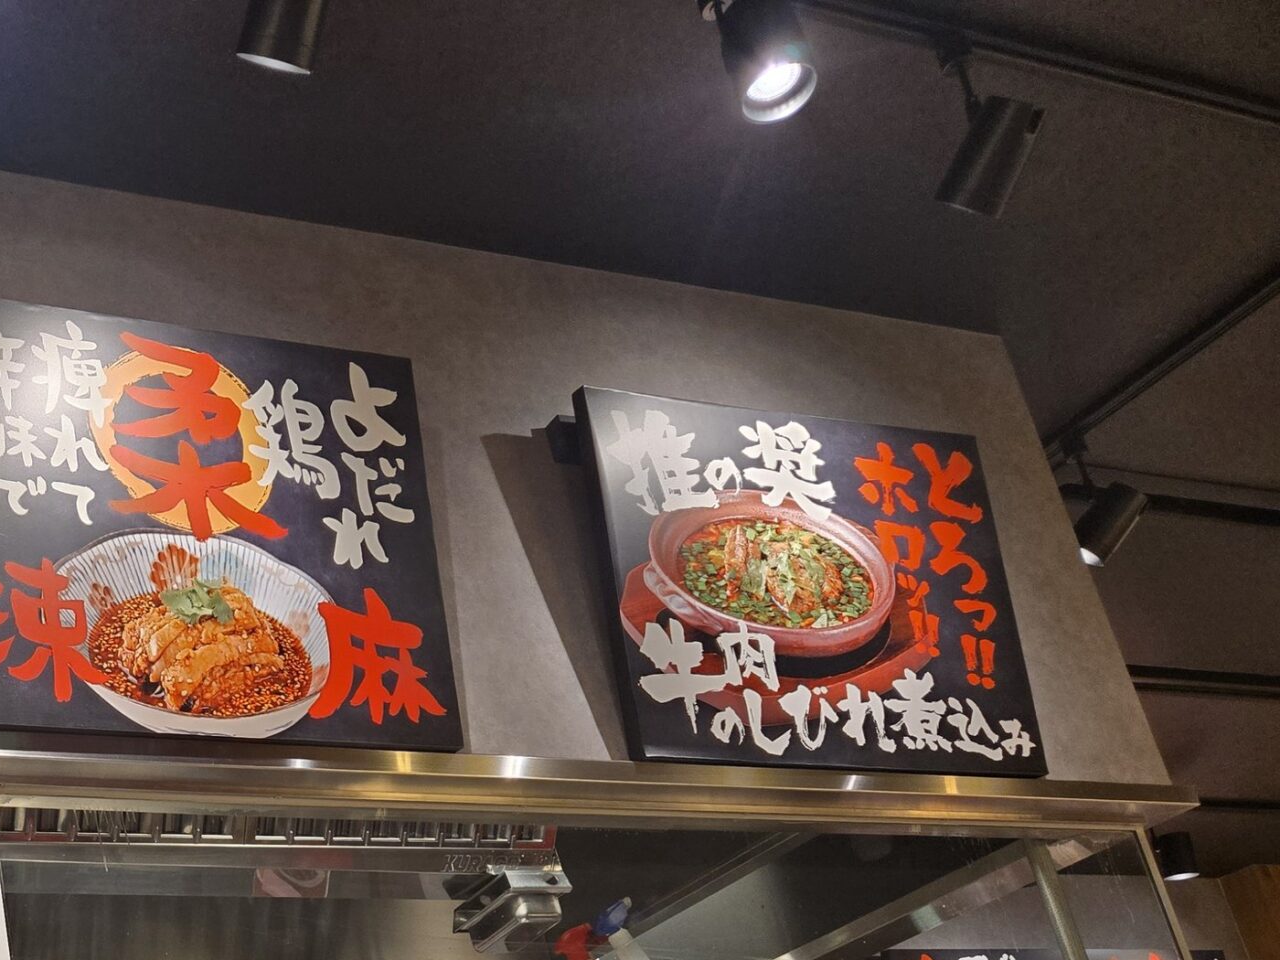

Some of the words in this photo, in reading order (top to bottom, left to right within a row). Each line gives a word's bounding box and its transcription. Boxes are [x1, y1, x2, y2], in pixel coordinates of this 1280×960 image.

[109, 331, 289, 542] 柔
[242, 378, 341, 500] 鶏
[323, 362, 416, 569] よだれ
[308, 587, 447, 725] 麻
